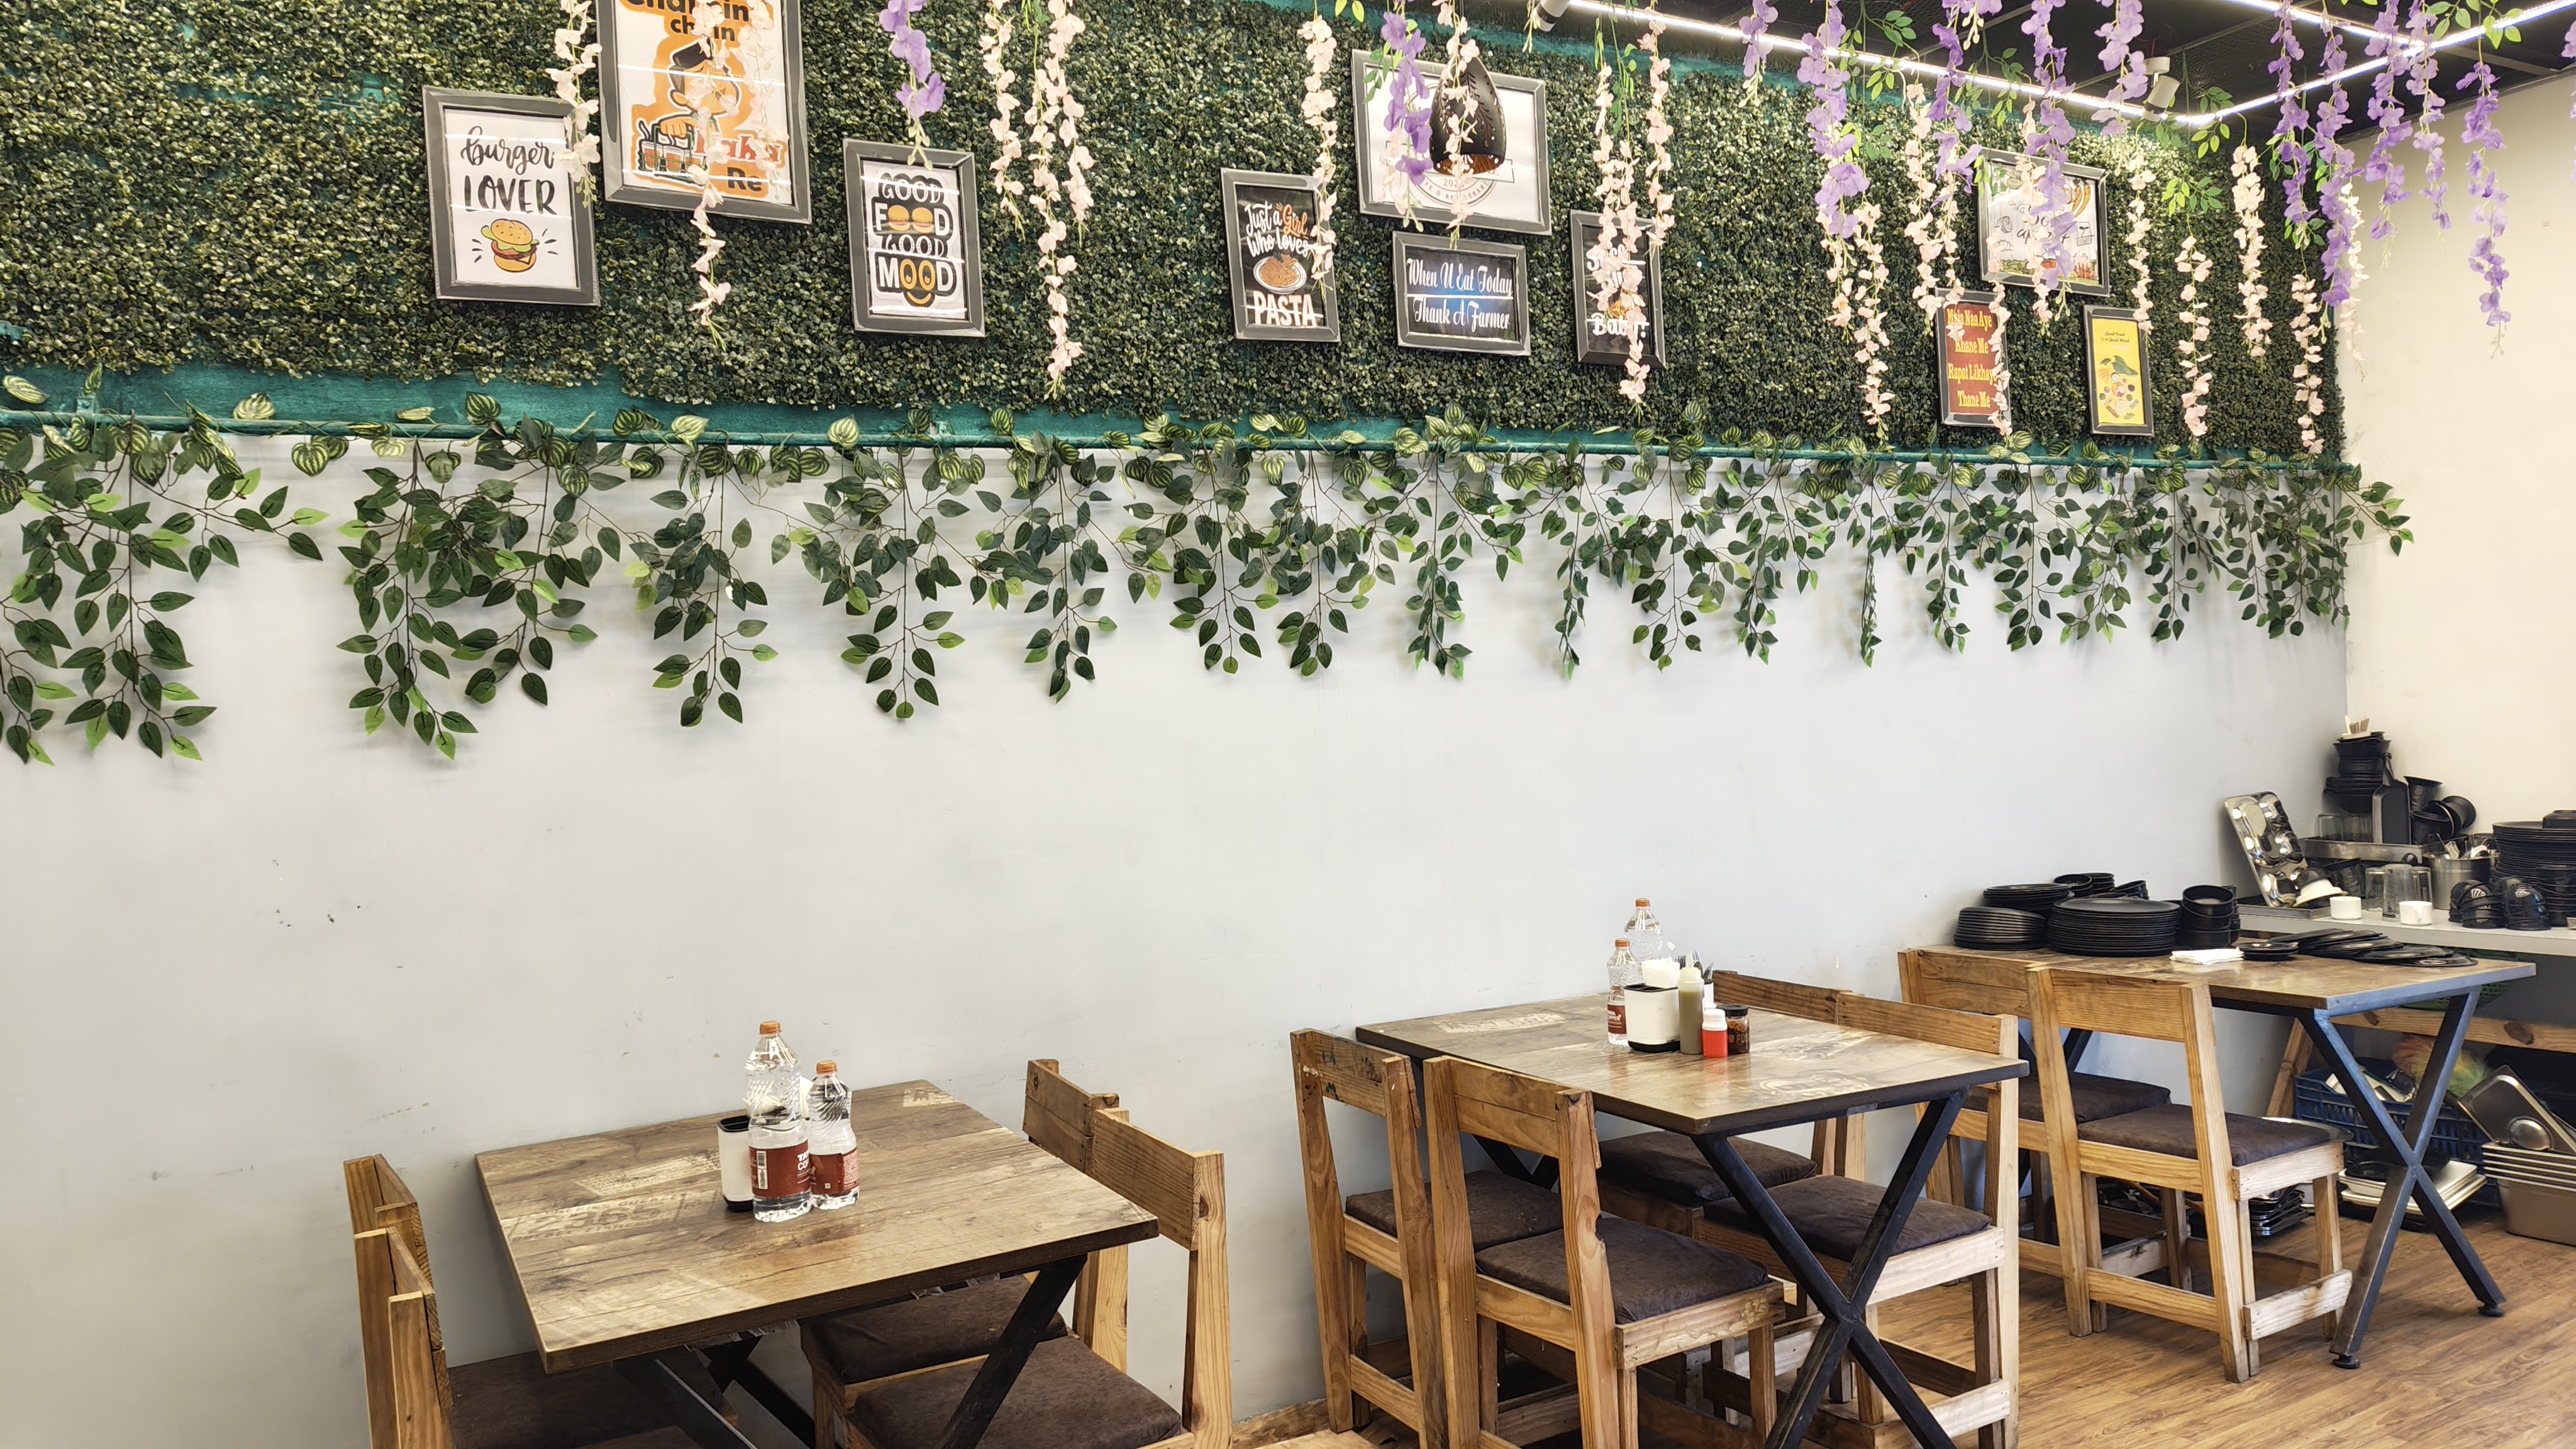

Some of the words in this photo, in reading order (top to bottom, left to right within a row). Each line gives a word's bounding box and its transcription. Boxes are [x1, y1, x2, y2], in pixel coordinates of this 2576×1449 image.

[670, 15, 735, 42] chin
[464, 175, 558, 216] LOVER
[882, 177, 942, 203] GOOD
[1245, 201, 1272, 236] Just
[1282, 203, 1308, 237] Girl
[886, 234, 945, 257] GOOD
[878, 256, 953, 292] MOOD
[1406, 257, 1438, 288] When
[1456, 263, 1474, 292] Eat
[1477, 265, 1513, 296] Today
[1252, 291, 1317, 326] PASTA
[1413, 297, 1451, 325] Thank
[1453, 299, 1465, 326] A
[1467, 300, 1511, 333] Farmer
[1979, 311, 1992, 331] Aye
[1977, 337, 1989, 355] Me
[1948, 363, 1968, 384] Rapat
[1957, 390, 1979, 408] Thane
[1979, 391, 1991, 408] Me
